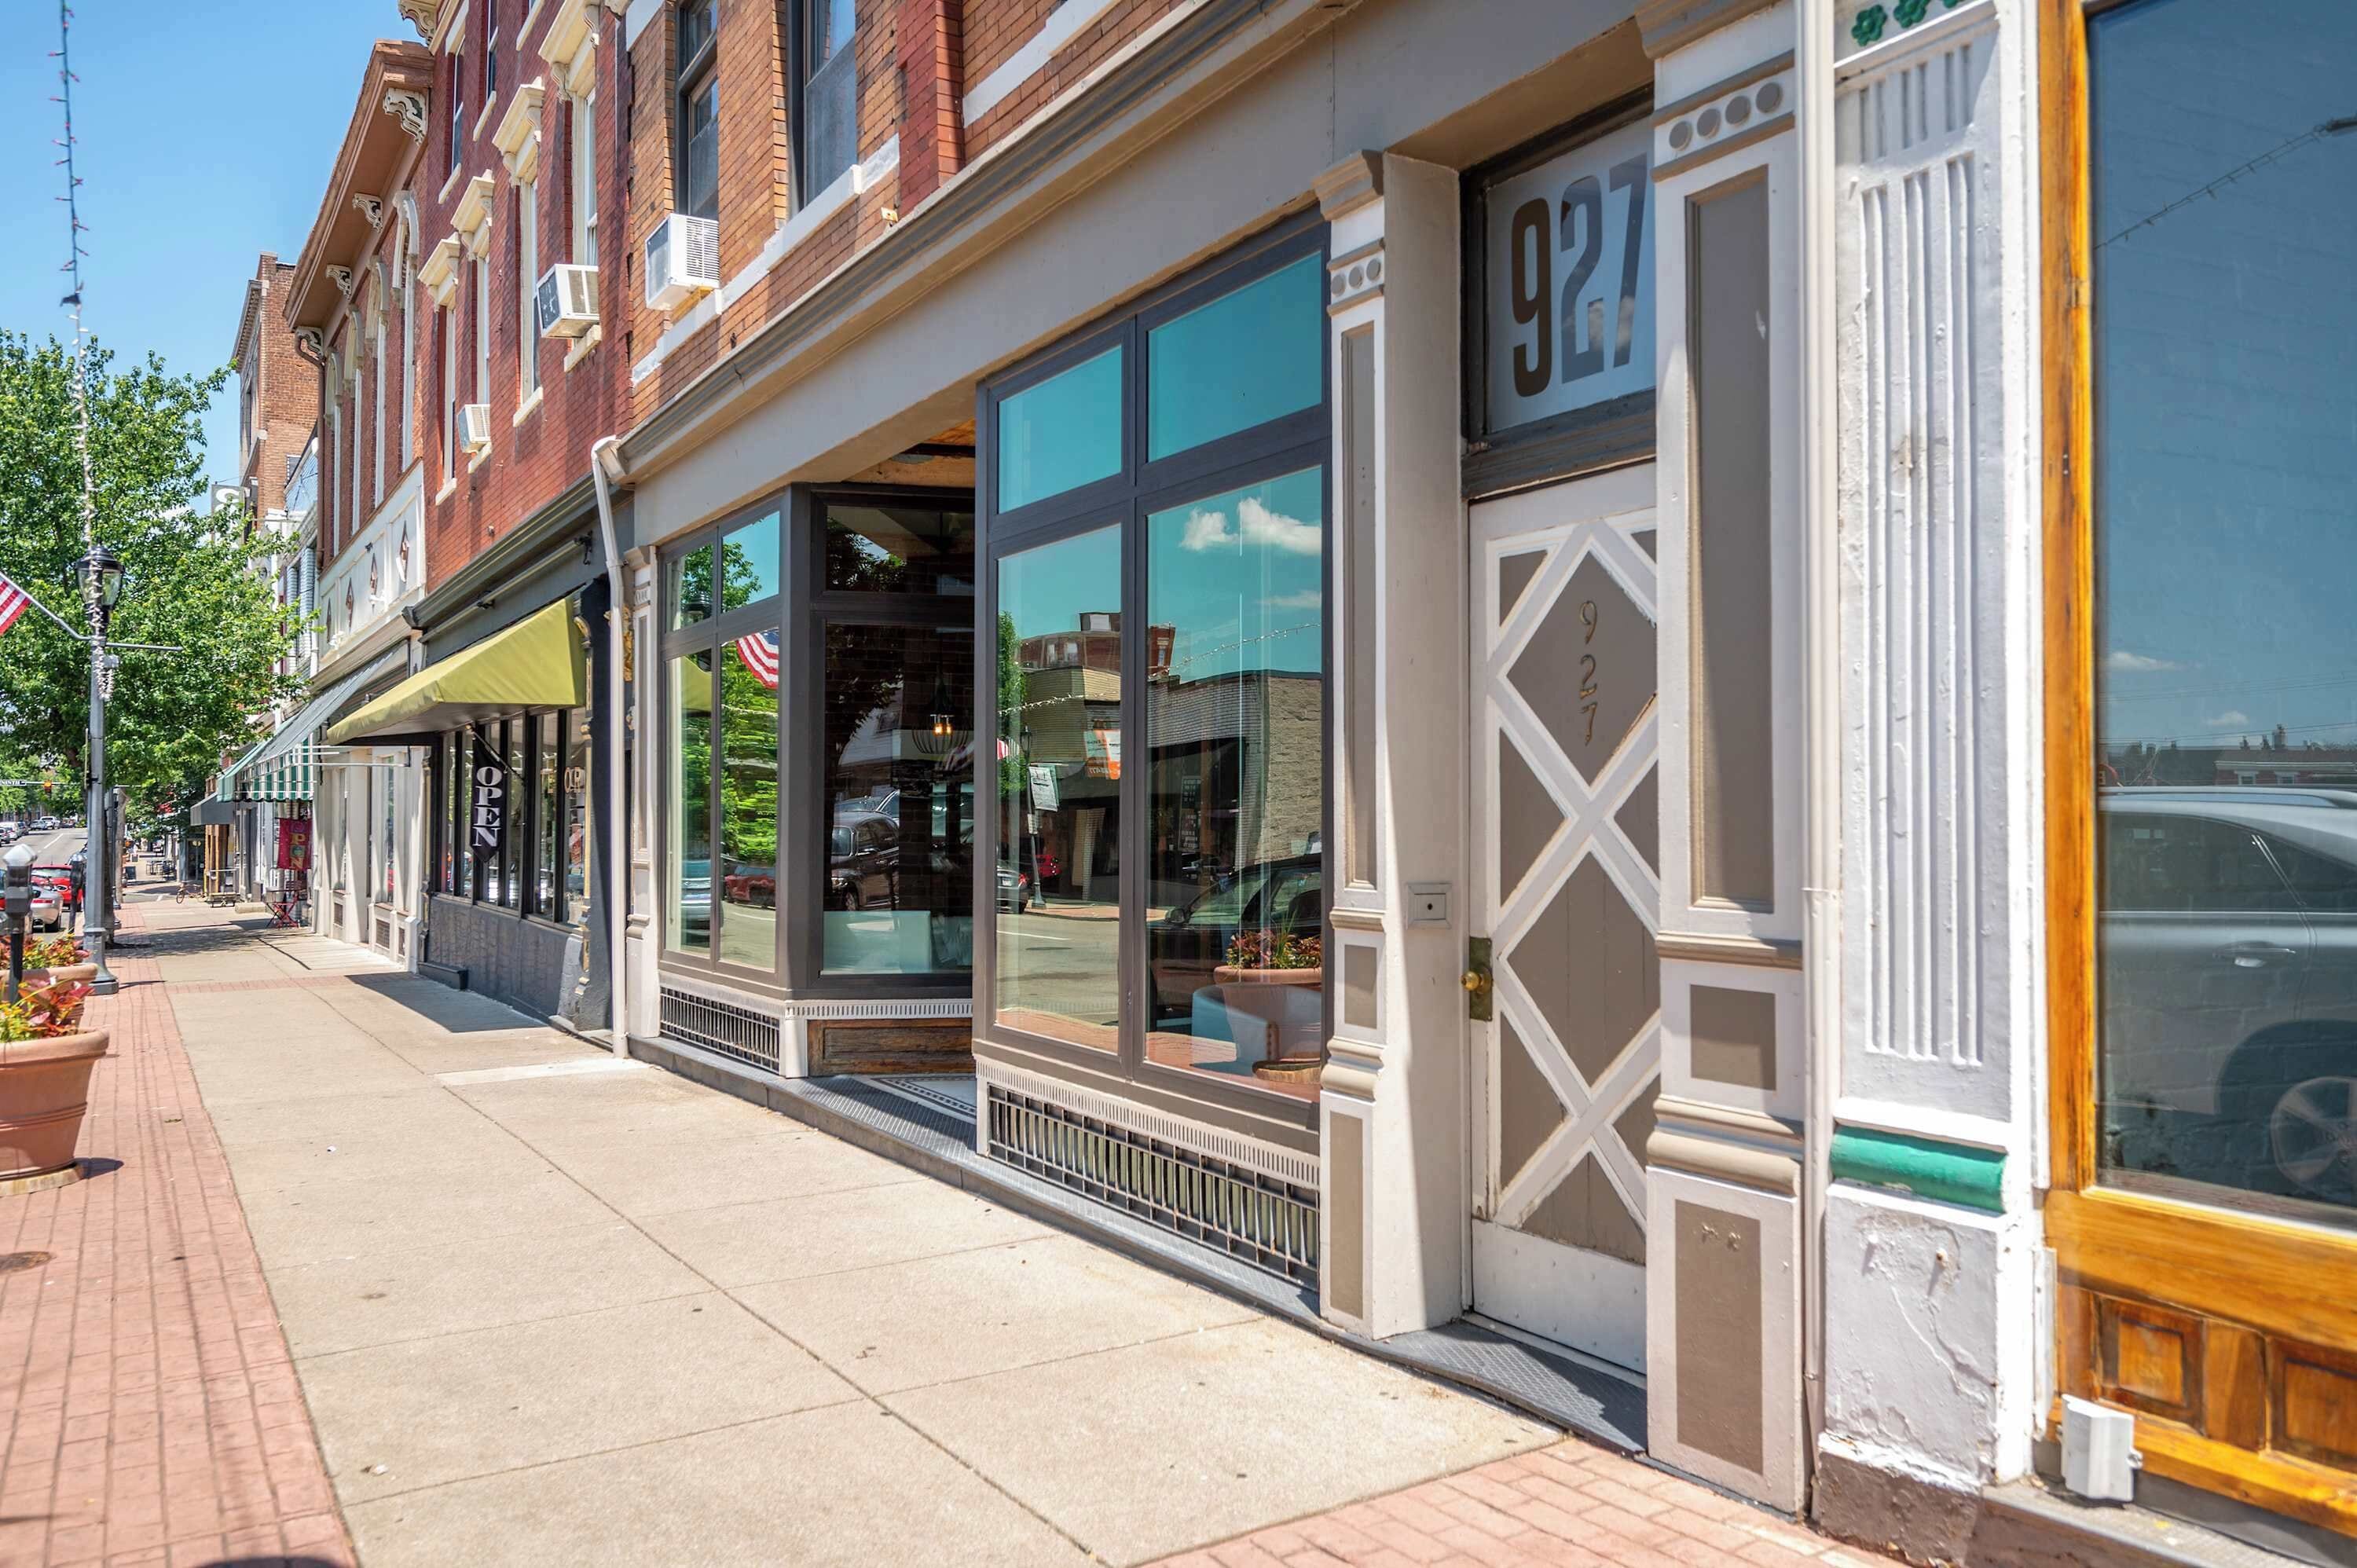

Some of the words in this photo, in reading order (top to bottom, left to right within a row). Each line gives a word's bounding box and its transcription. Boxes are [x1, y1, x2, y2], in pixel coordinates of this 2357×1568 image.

[1511, 152, 1648, 397] 927
[1579, 600, 1598, 746] 927
[472, 766, 503, 847] OPEN
